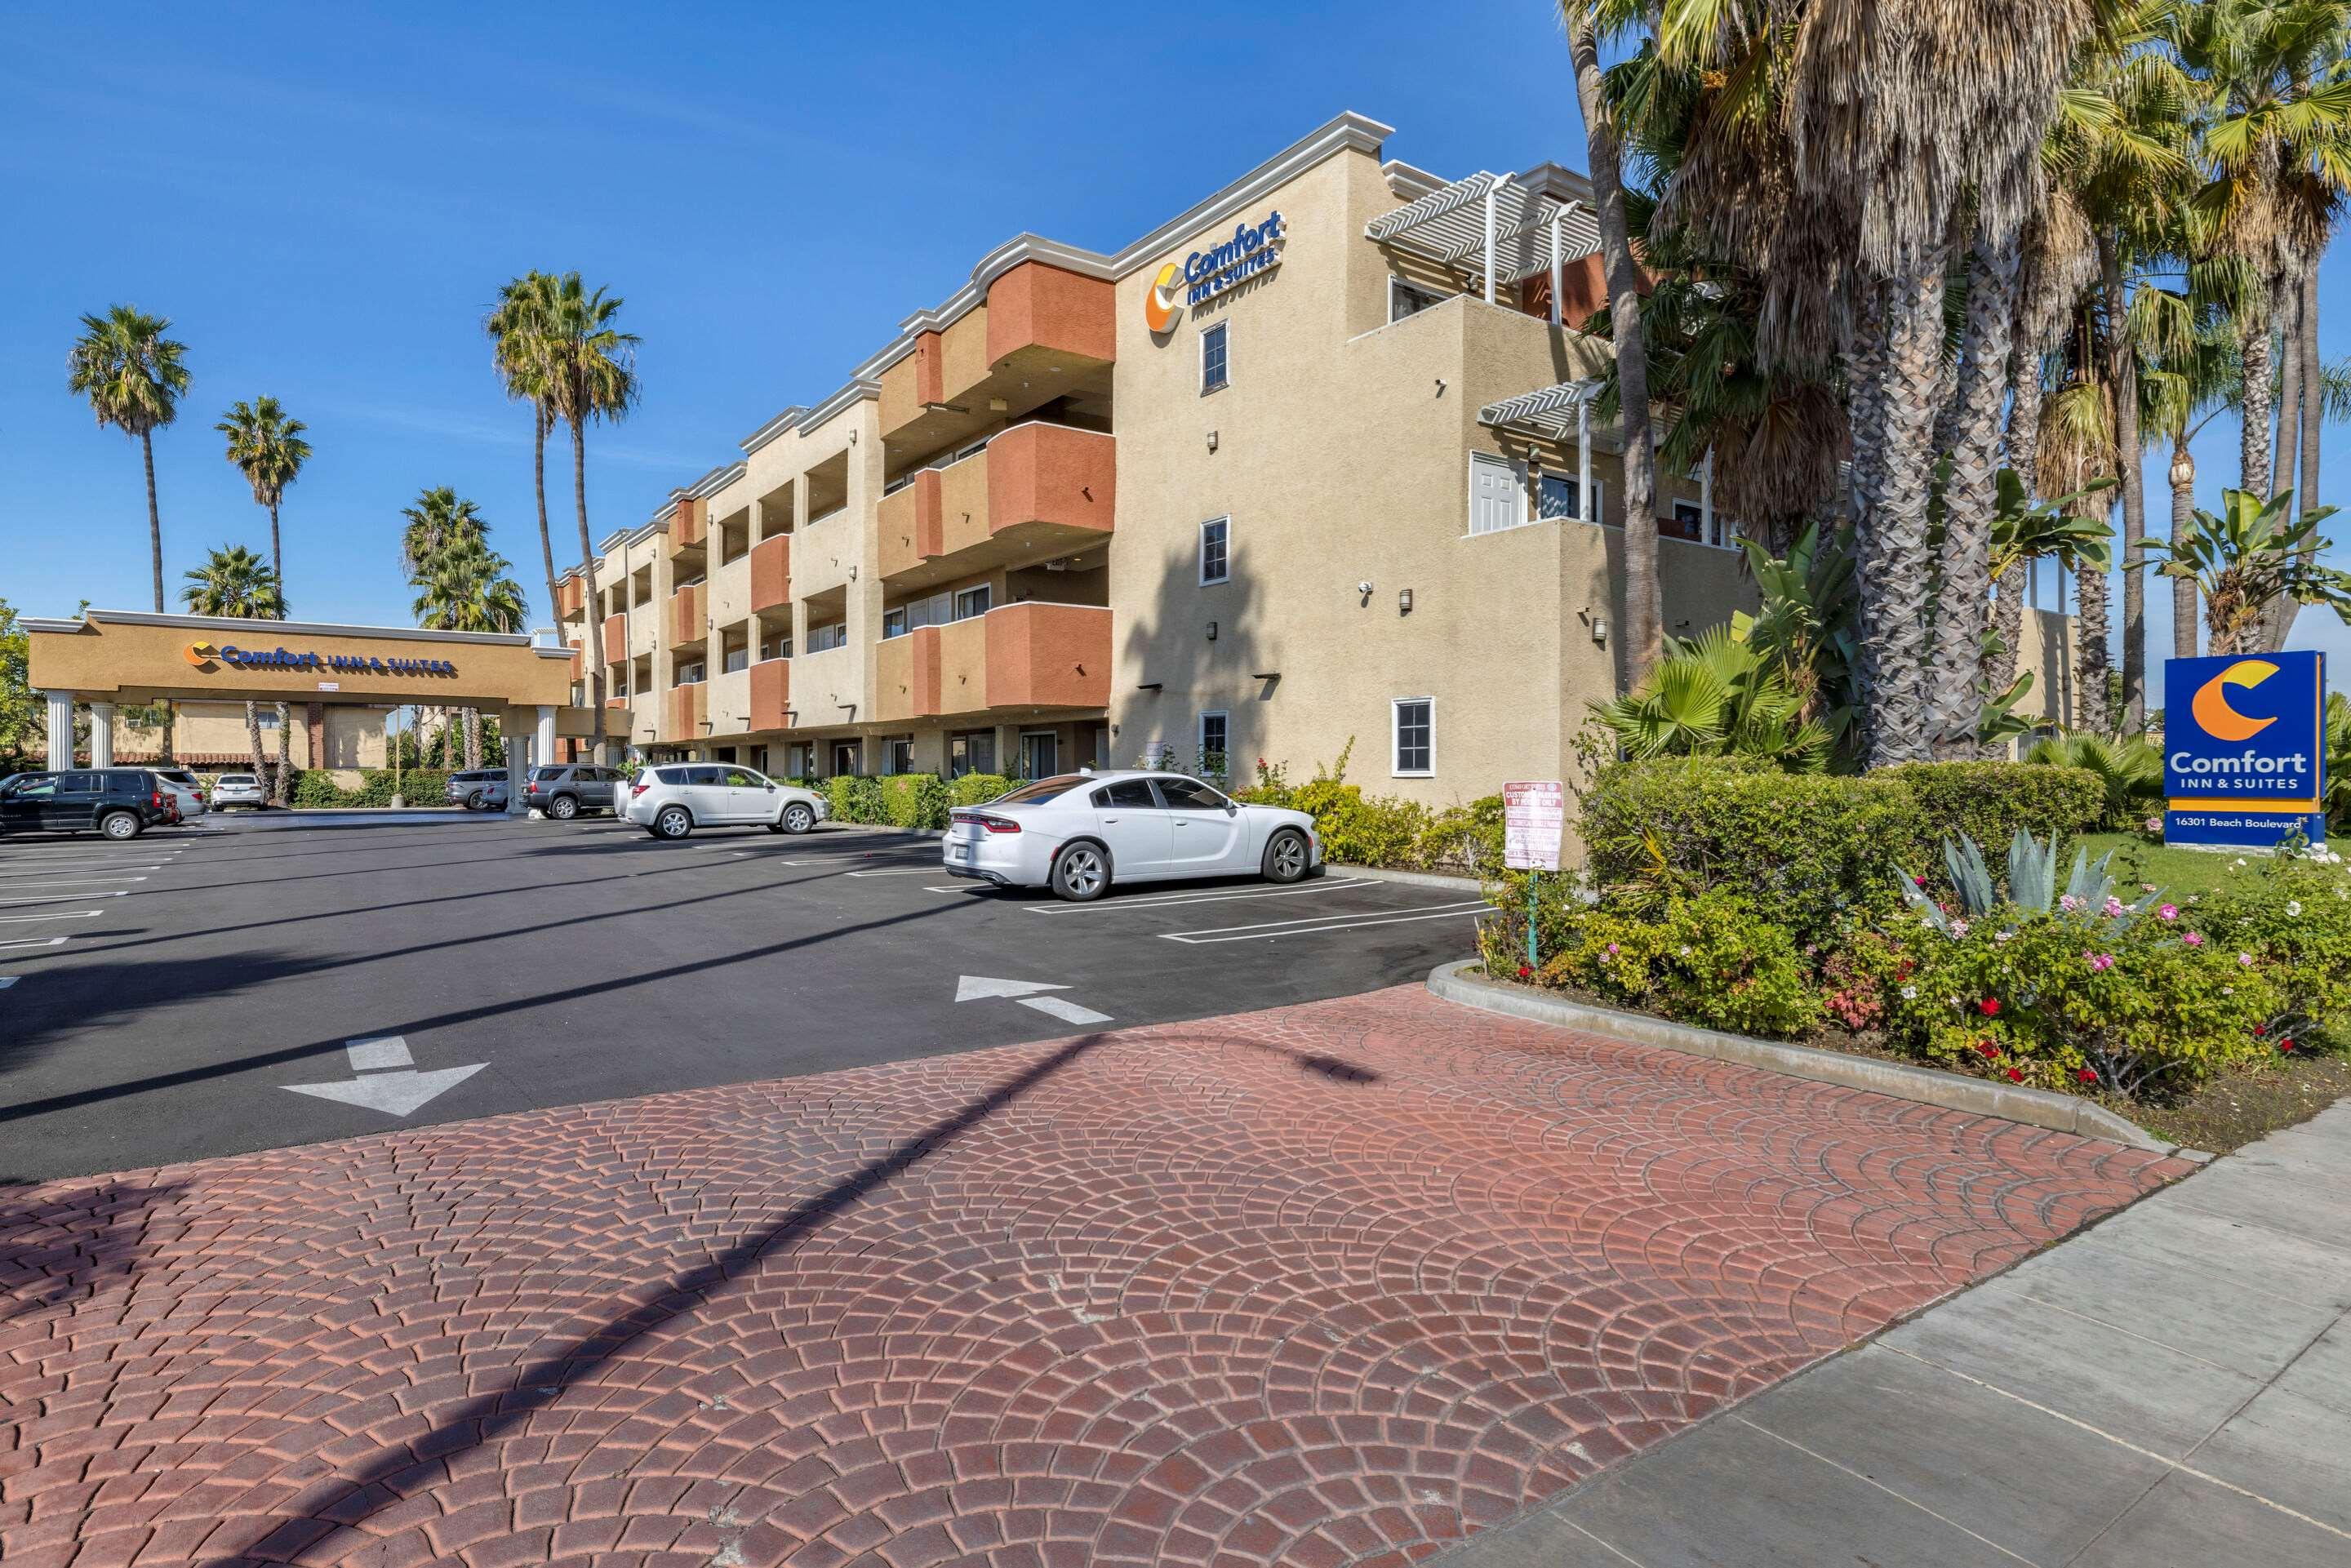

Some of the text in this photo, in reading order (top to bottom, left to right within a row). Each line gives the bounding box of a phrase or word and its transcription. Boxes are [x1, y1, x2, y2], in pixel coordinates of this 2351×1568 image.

[1184, 210, 1282, 284] Comfort
[1187, 247, 1276, 306] INN & SUITES
[220, 645, 453, 673] Comfort INN & SUITES
[2170, 749, 2306, 774] Comfort
[1506, 791, 1535, 799] CUSTOM
[2180, 778, 2299, 789] INN & SUITES
[2175, 817, 2301, 828] 16301 Beach Boulevard
